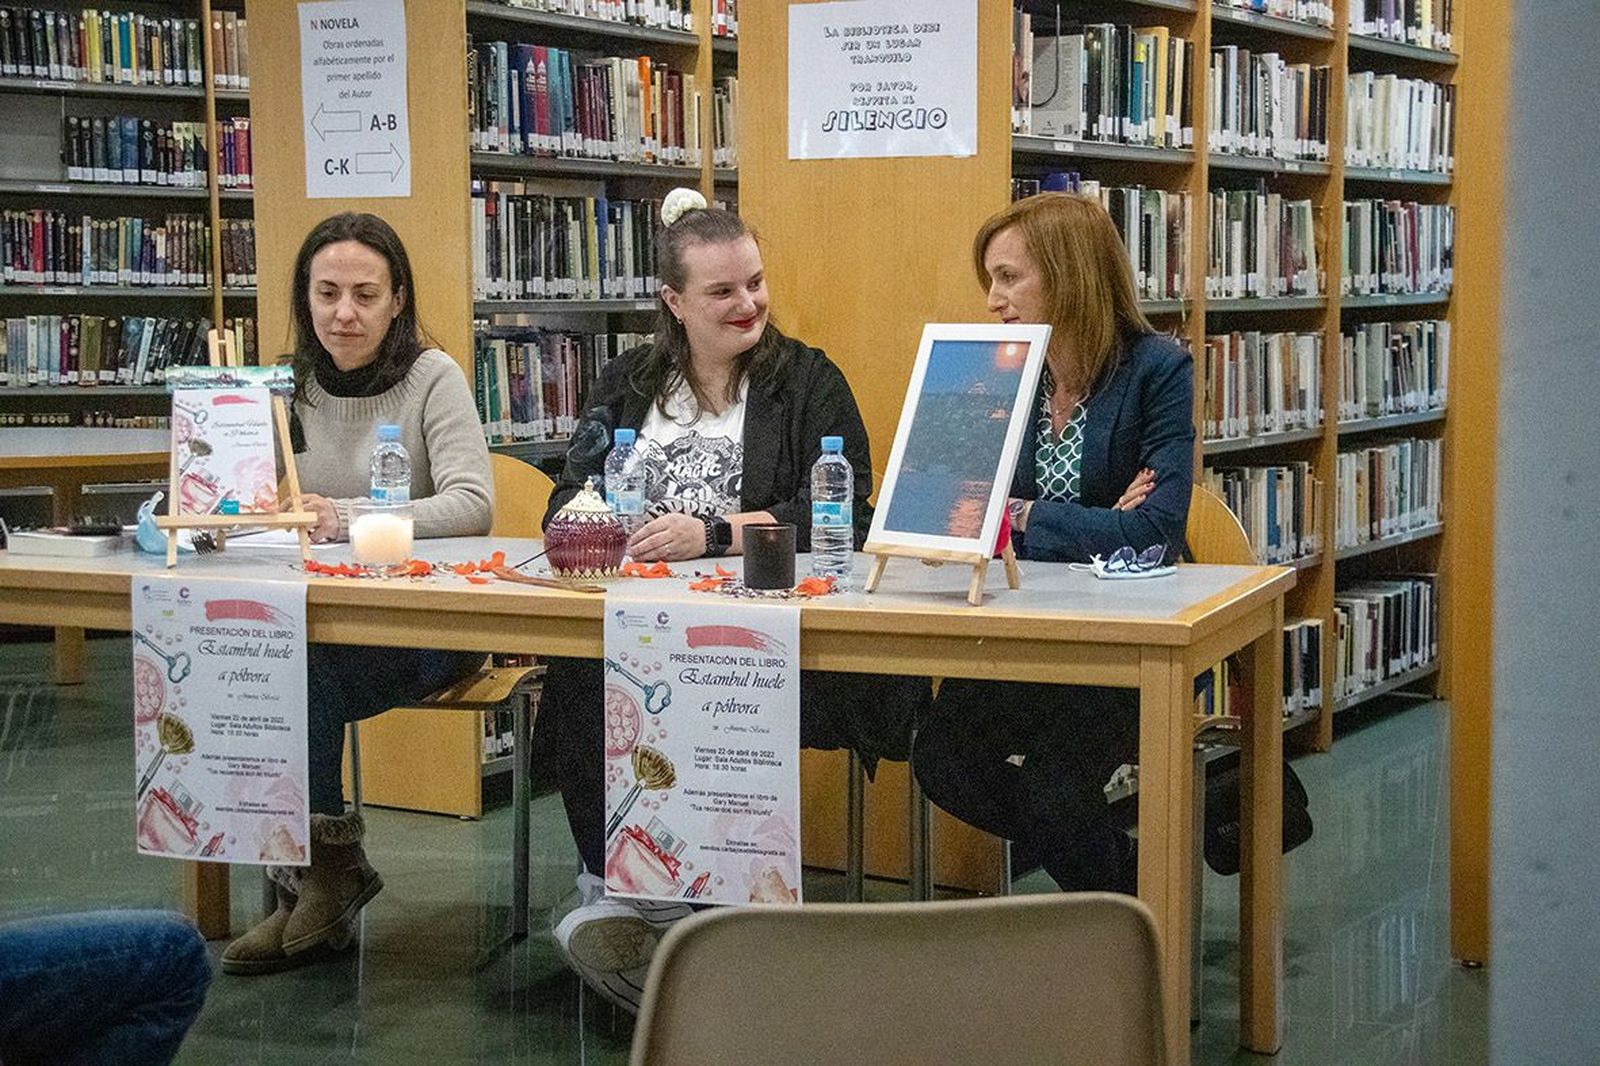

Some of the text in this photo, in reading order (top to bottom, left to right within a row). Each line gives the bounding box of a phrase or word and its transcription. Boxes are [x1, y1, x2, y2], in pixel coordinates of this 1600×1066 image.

[310, 18, 360, 30] N NOVELA
[824, 23, 940, 38] LA BIBLIOTECA DEBE
[323, 38, 384, 49] Obras ordenadas
[841, 38, 922, 51] SER UN LUGAR
[313, 54, 394, 66] alfabéticamente por el
[850, 53, 912, 64] TRANQUILO
[326, 72, 382, 83] primer apellido
[850, 82, 872, 92] POR
[338, 90, 372, 99] del Autor
[903, 96, 915, 104] EL
[370, 114, 397, 131] A-B
[822, 108, 948, 132] SILENCIO
[324, 158, 350, 175] C-K
[664, 463, 722, 480] MAGIC
[190, 626, 294, 640] PRESENTACIÓN DEL LIBRO
[198, 640, 293, 660] Estambul huele
[670, 654, 786, 668] PRESENTACIÓN DEL LIBRO
[218, 668, 270, 686] a pólvora
[679, 668, 786, 690] Estambul huele
[701, 698, 760, 718] a pólvora
